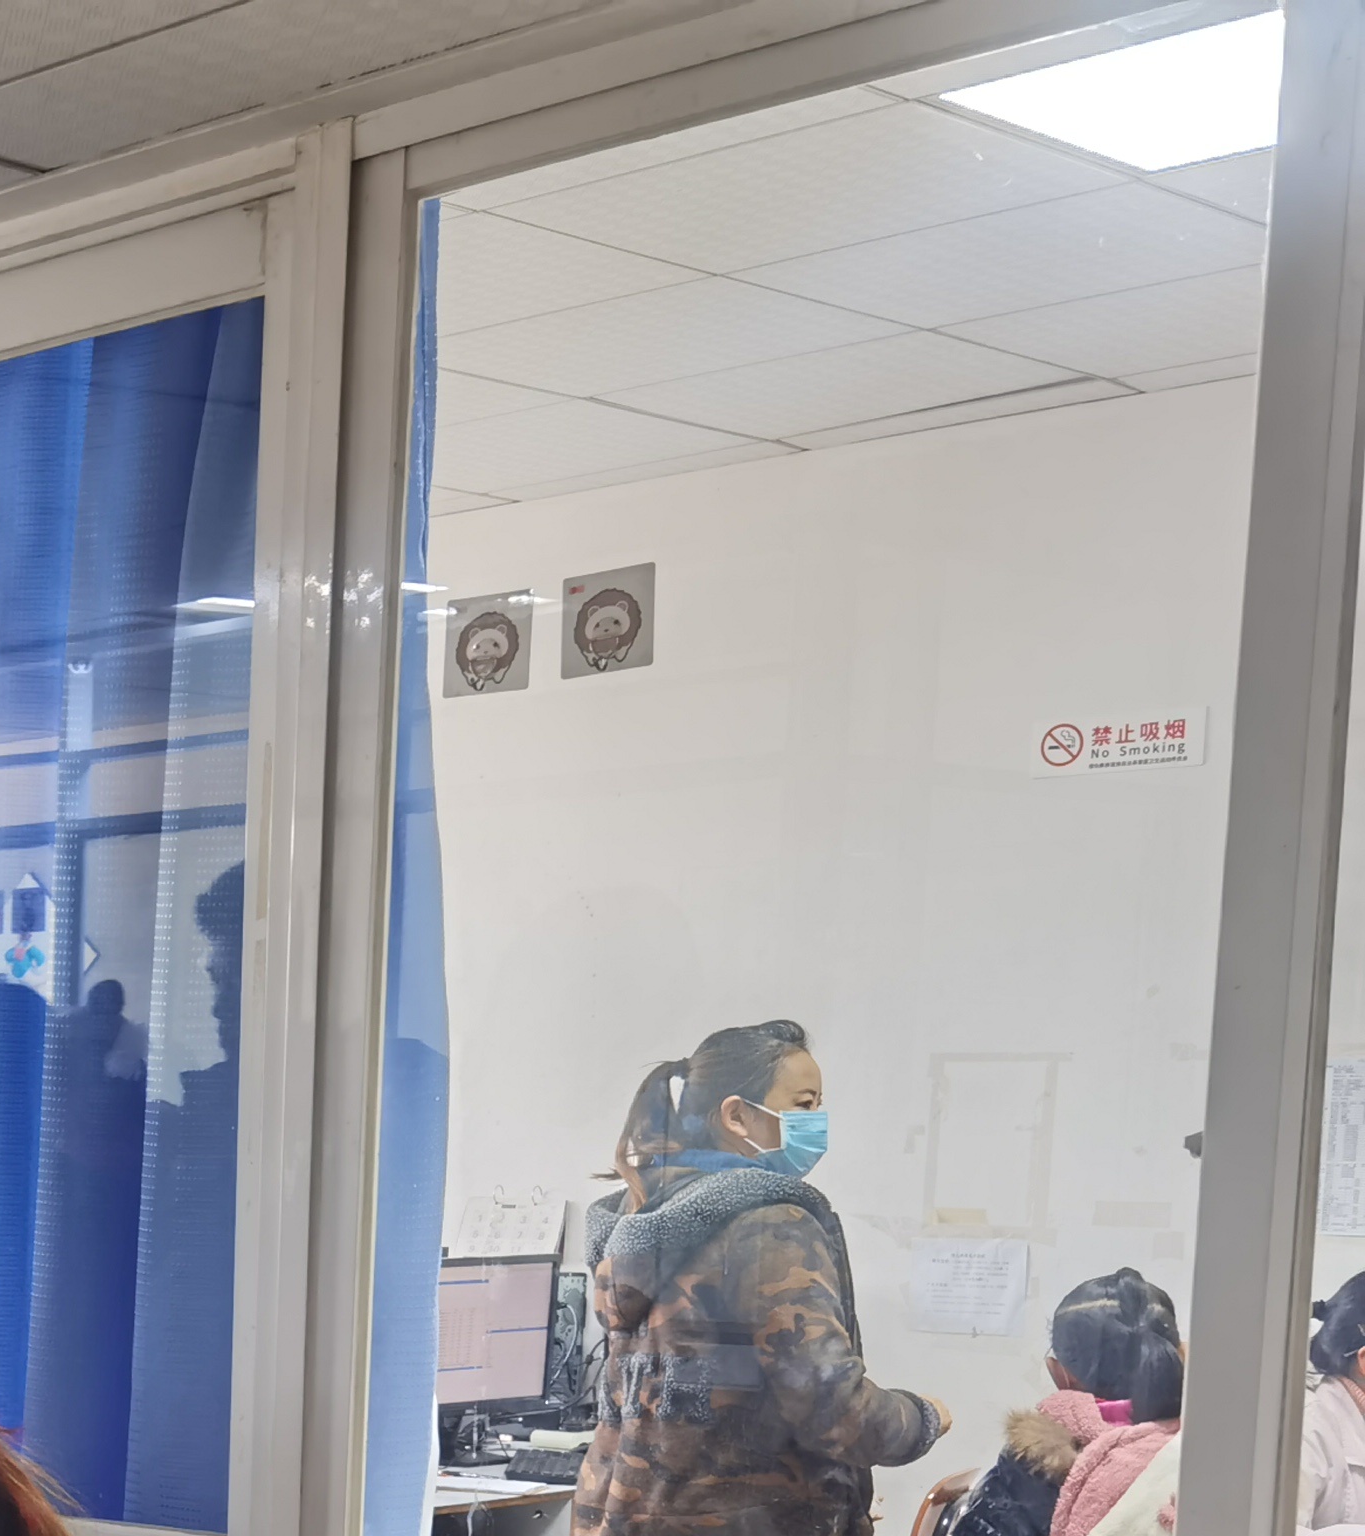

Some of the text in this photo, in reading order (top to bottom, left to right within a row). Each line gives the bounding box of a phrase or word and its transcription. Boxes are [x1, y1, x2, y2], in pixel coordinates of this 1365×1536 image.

[1091, 718, 1187, 747] 禁止吸烟
[1090, 741, 1186, 759] No Smoking
